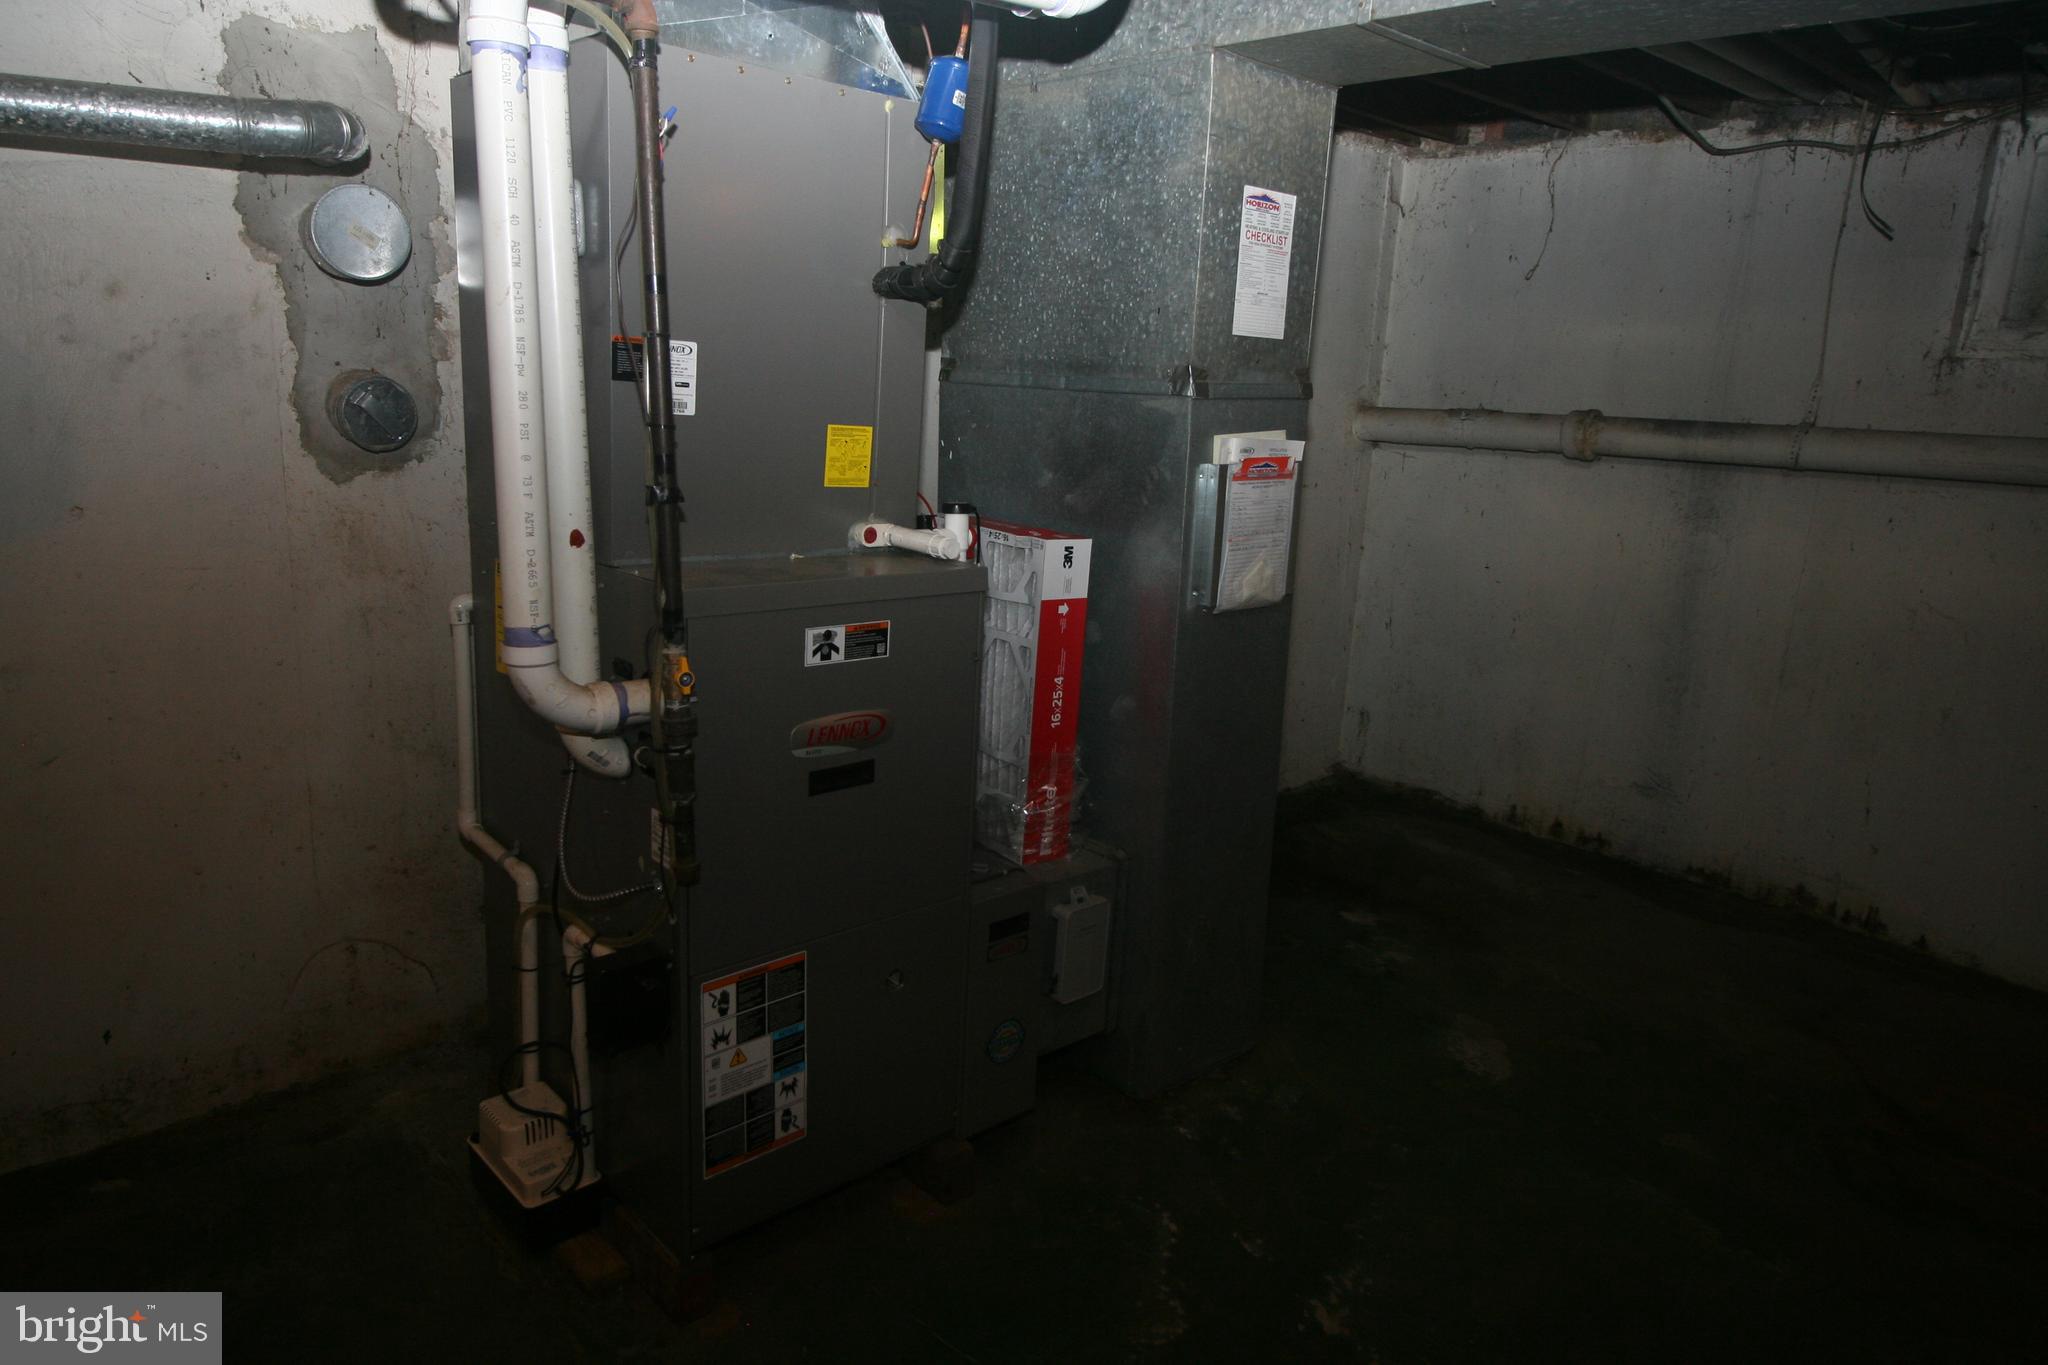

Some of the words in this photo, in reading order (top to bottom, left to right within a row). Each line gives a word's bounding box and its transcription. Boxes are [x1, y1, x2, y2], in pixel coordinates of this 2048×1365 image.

[504, 101, 513, 122] PVC
[505, 138, 517, 164] 1120
[507, 177, 518, 199] SCH
[1246, 199, 1280, 212] HORIZON
[509, 214, 520, 226] 40
[1245, 229, 1288, 246] CHECKLIST
[511, 240, 521, 268] ASTM
[513, 281, 525, 324] D-1785
[514, 336, 526, 377] NSF-pw
[517, 391, 529, 410] 280
[520, 423, 530, 441] PSI
[524, 511, 535, 538] ASTM
[526, 549, 539, 588] D-2665
[1063, 546, 1074, 568] 3M
[1050, 676, 1065, 729] 16x25x4
[806, 719, 873, 747] LENNOX
